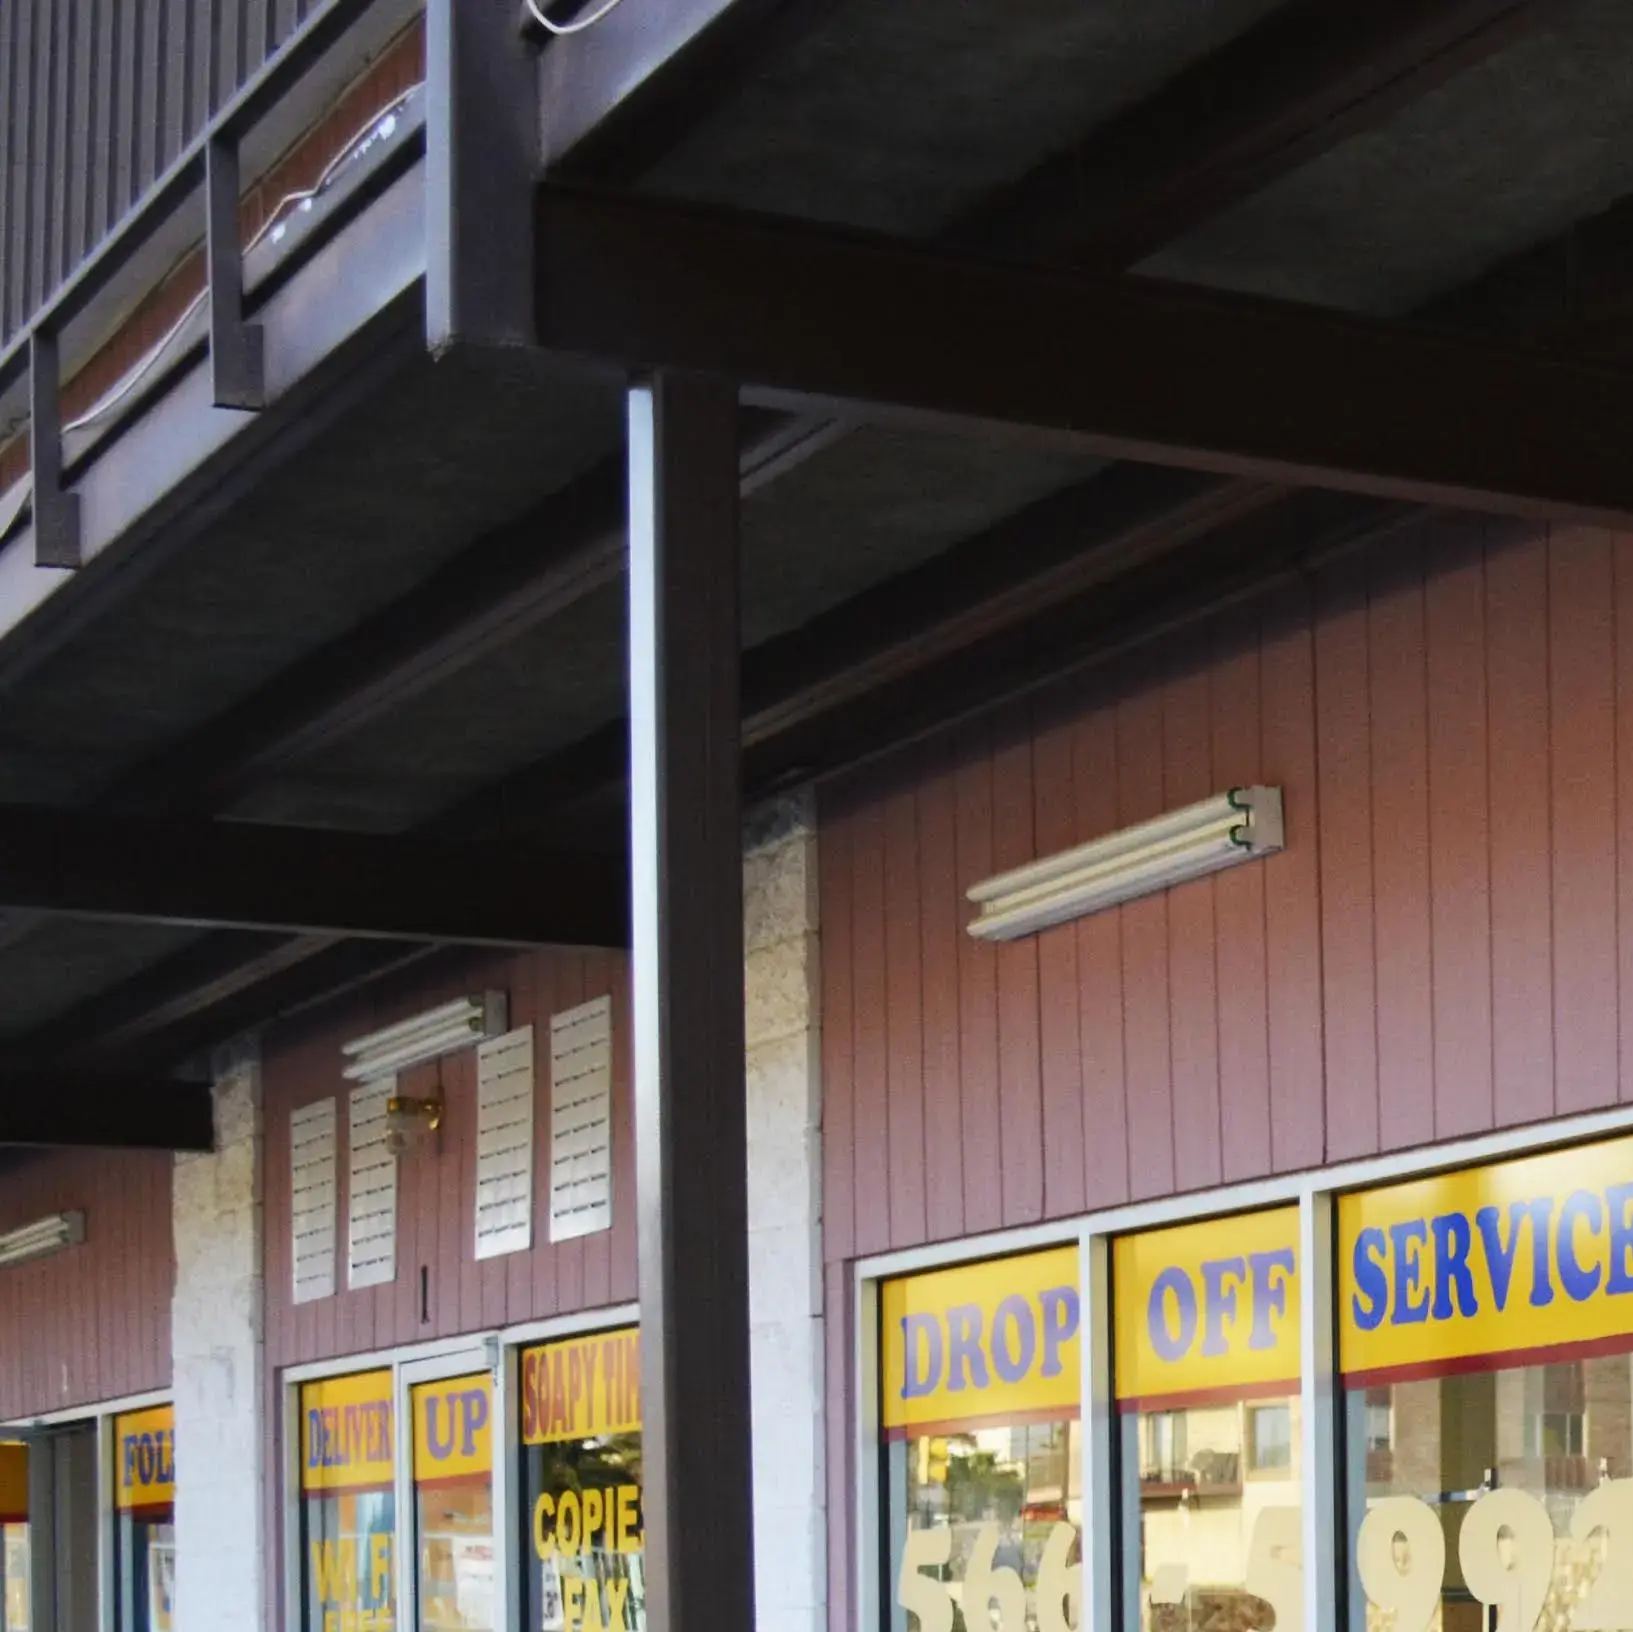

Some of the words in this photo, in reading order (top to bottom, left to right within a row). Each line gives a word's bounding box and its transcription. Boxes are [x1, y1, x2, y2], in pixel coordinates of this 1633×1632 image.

[900, 1284, 1080, 1400] DROP
[1147, 1247, 1295, 1363] OFF
[308, 1398, 394, 1468] DELIVER
[424, 1389, 487, 1460] UP
[524, 1344, 599, 1438] SOAPY
[123, 1429, 175, 1486] FOL
[534, 1485, 645, 1560] COPIE
